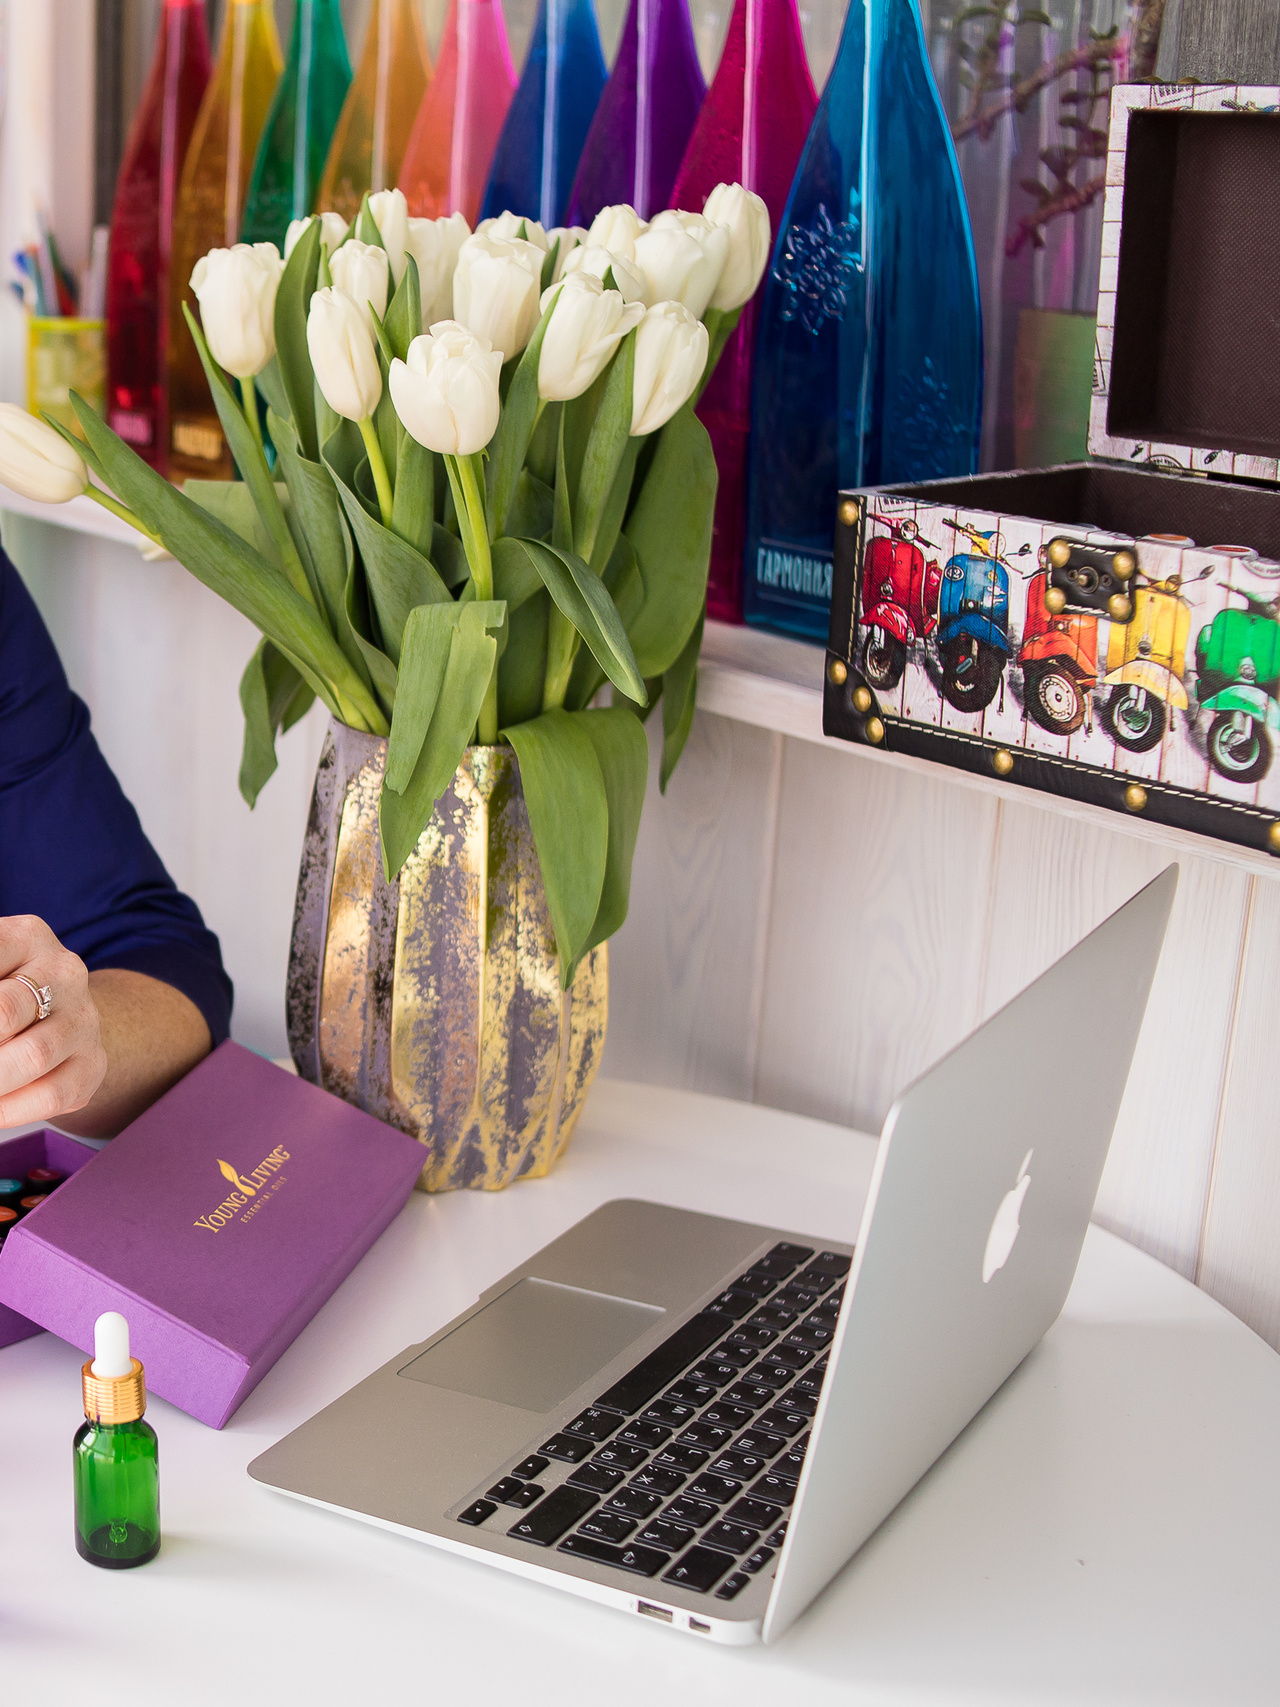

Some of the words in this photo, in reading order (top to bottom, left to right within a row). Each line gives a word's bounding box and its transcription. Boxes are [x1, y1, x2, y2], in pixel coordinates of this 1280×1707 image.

[757, 547, 834, 600] ГАРМОНИЯ
[193, 1191, 248, 1234] YOUNG
[239, 1147, 291, 1190] LIVING
[240, 1191, 274, 1224] ESSENTIAL
